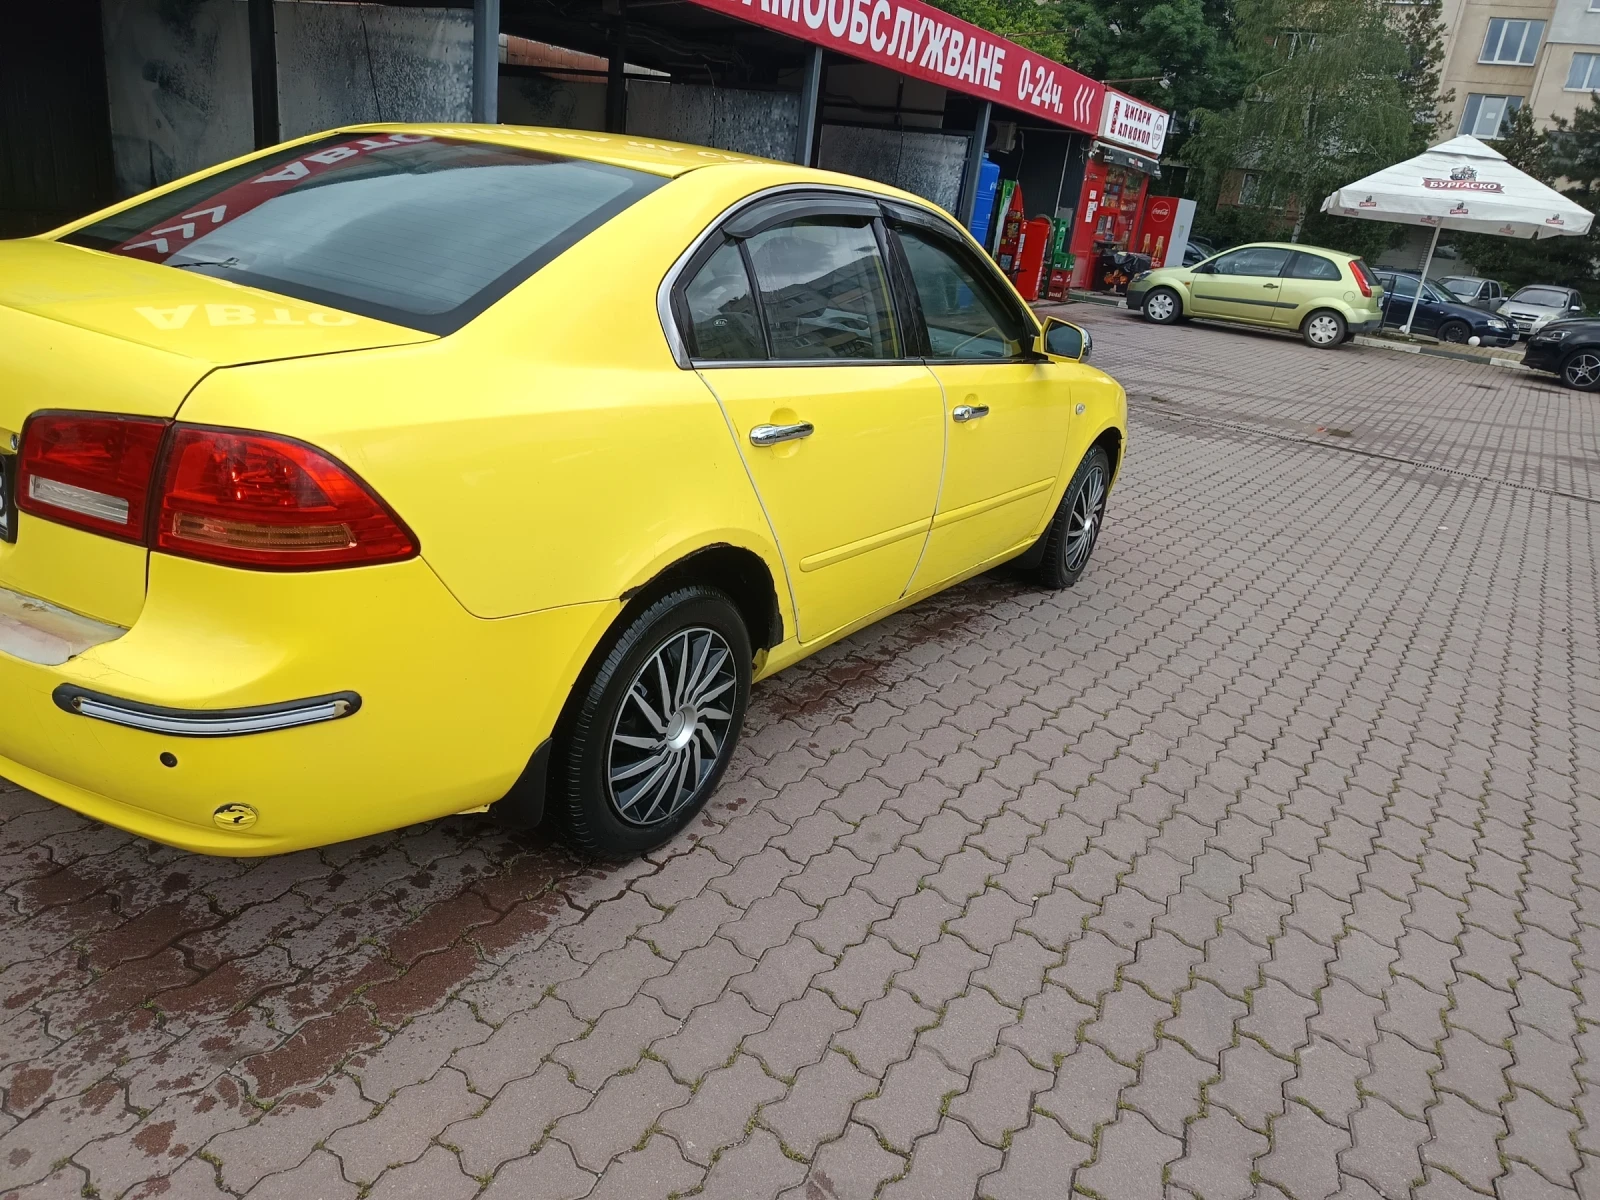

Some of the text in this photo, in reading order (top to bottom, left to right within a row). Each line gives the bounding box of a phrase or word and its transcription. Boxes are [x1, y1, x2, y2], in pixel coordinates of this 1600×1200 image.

[1018, 59, 1063, 114] 0-24ч.
[1124, 103, 1152, 126] ЦИГАРИ
[1429, 181, 1497, 190] БУРГАСКО
